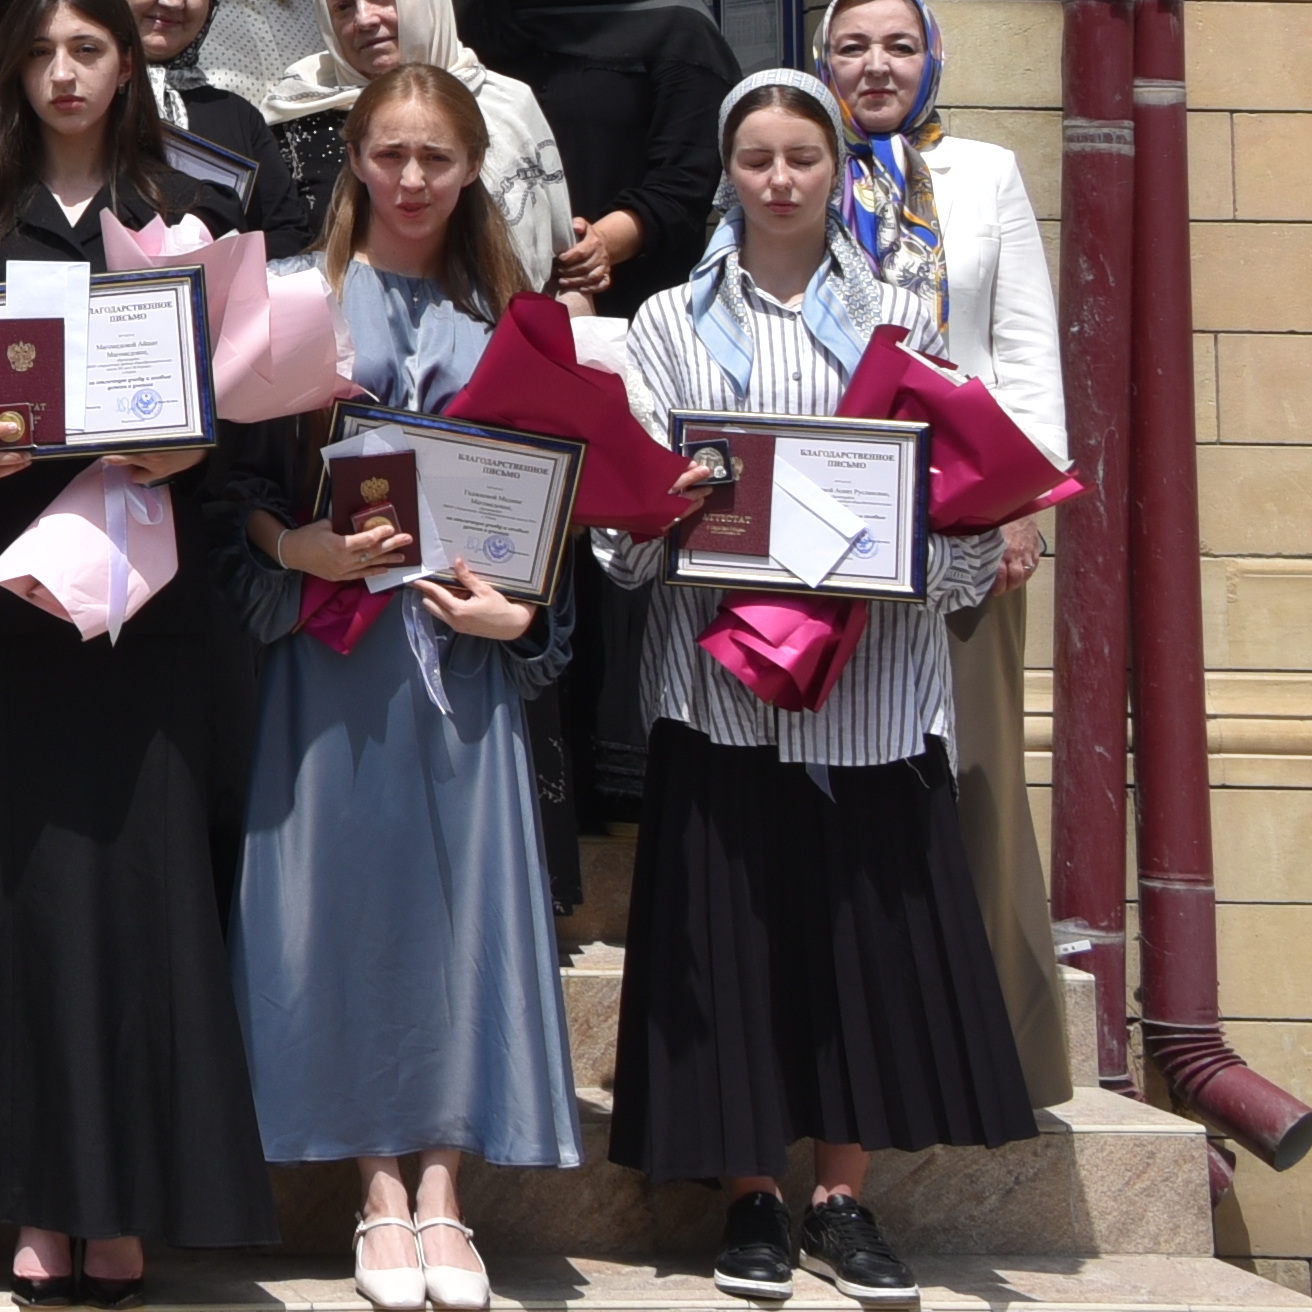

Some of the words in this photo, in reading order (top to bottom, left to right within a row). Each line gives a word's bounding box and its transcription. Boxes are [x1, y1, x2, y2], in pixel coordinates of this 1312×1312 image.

[90, 301, 173, 315] ЛАГОДАРСТВЕННОЕ
[800, 449, 895, 462] БЛАГОДАРСТВЕННОЕ
[458, 453, 549, 476] БЛАГОДАРСТВЕННОЕ
[827, 460, 867, 469] ПИСЬМО
[482, 467, 521, 480] ПИСЬМО
